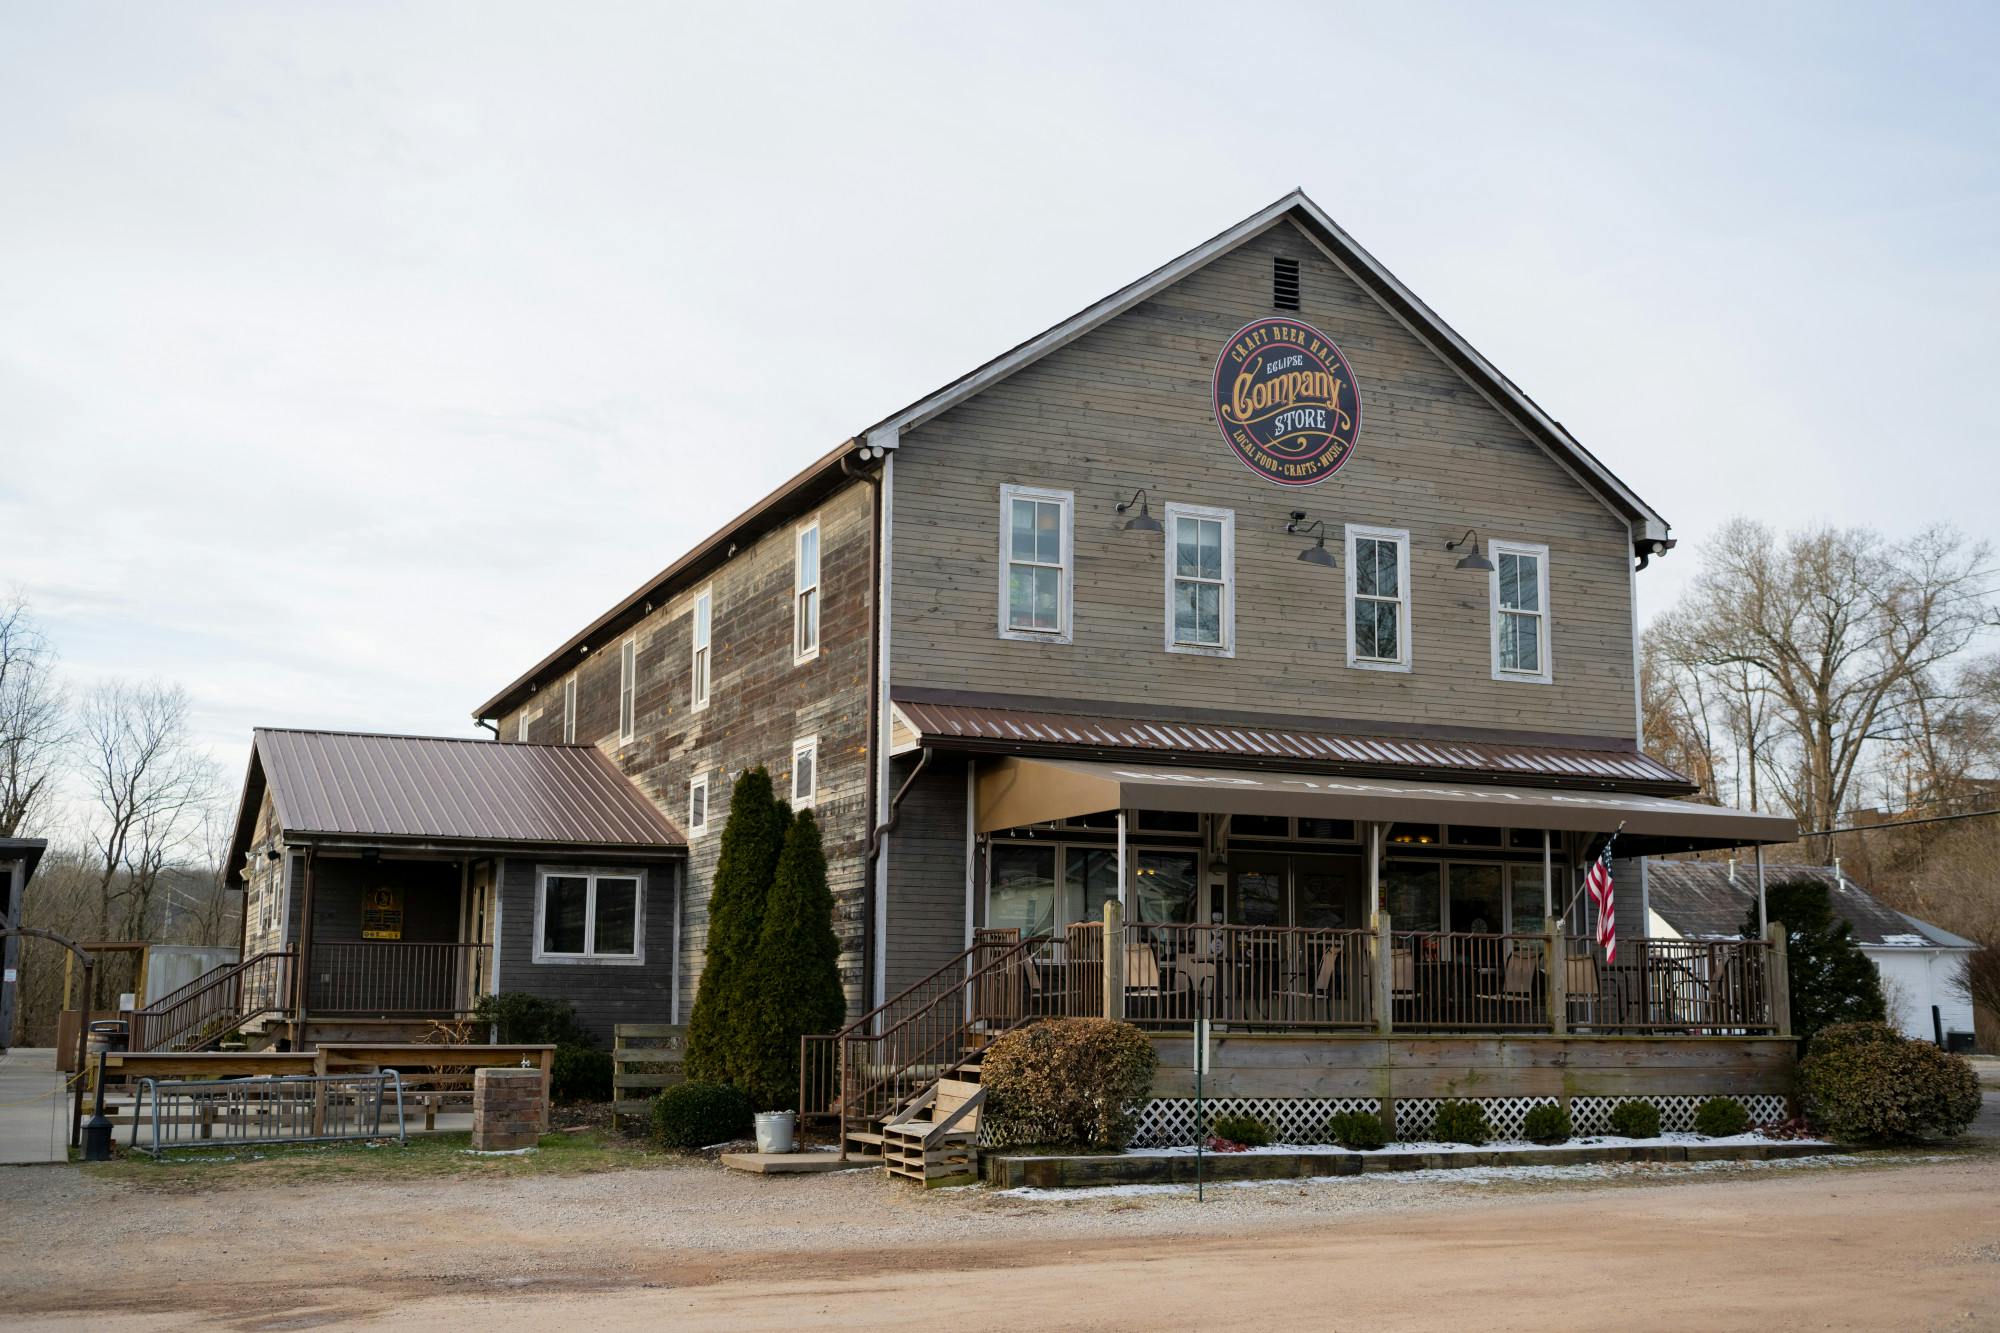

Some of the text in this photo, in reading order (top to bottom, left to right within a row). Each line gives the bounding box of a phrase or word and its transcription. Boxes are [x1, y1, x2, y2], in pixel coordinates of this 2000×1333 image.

[1231, 326, 1341, 374] CRAFT BEER HALL
[1266, 354, 1304, 375] ECLIPSE
[1232, 356, 1342, 420] Company
[1274, 408, 1327, 437] STORE
[1233, 429, 1343, 477] LOCAL FOOD CRAFTS MUSIC
